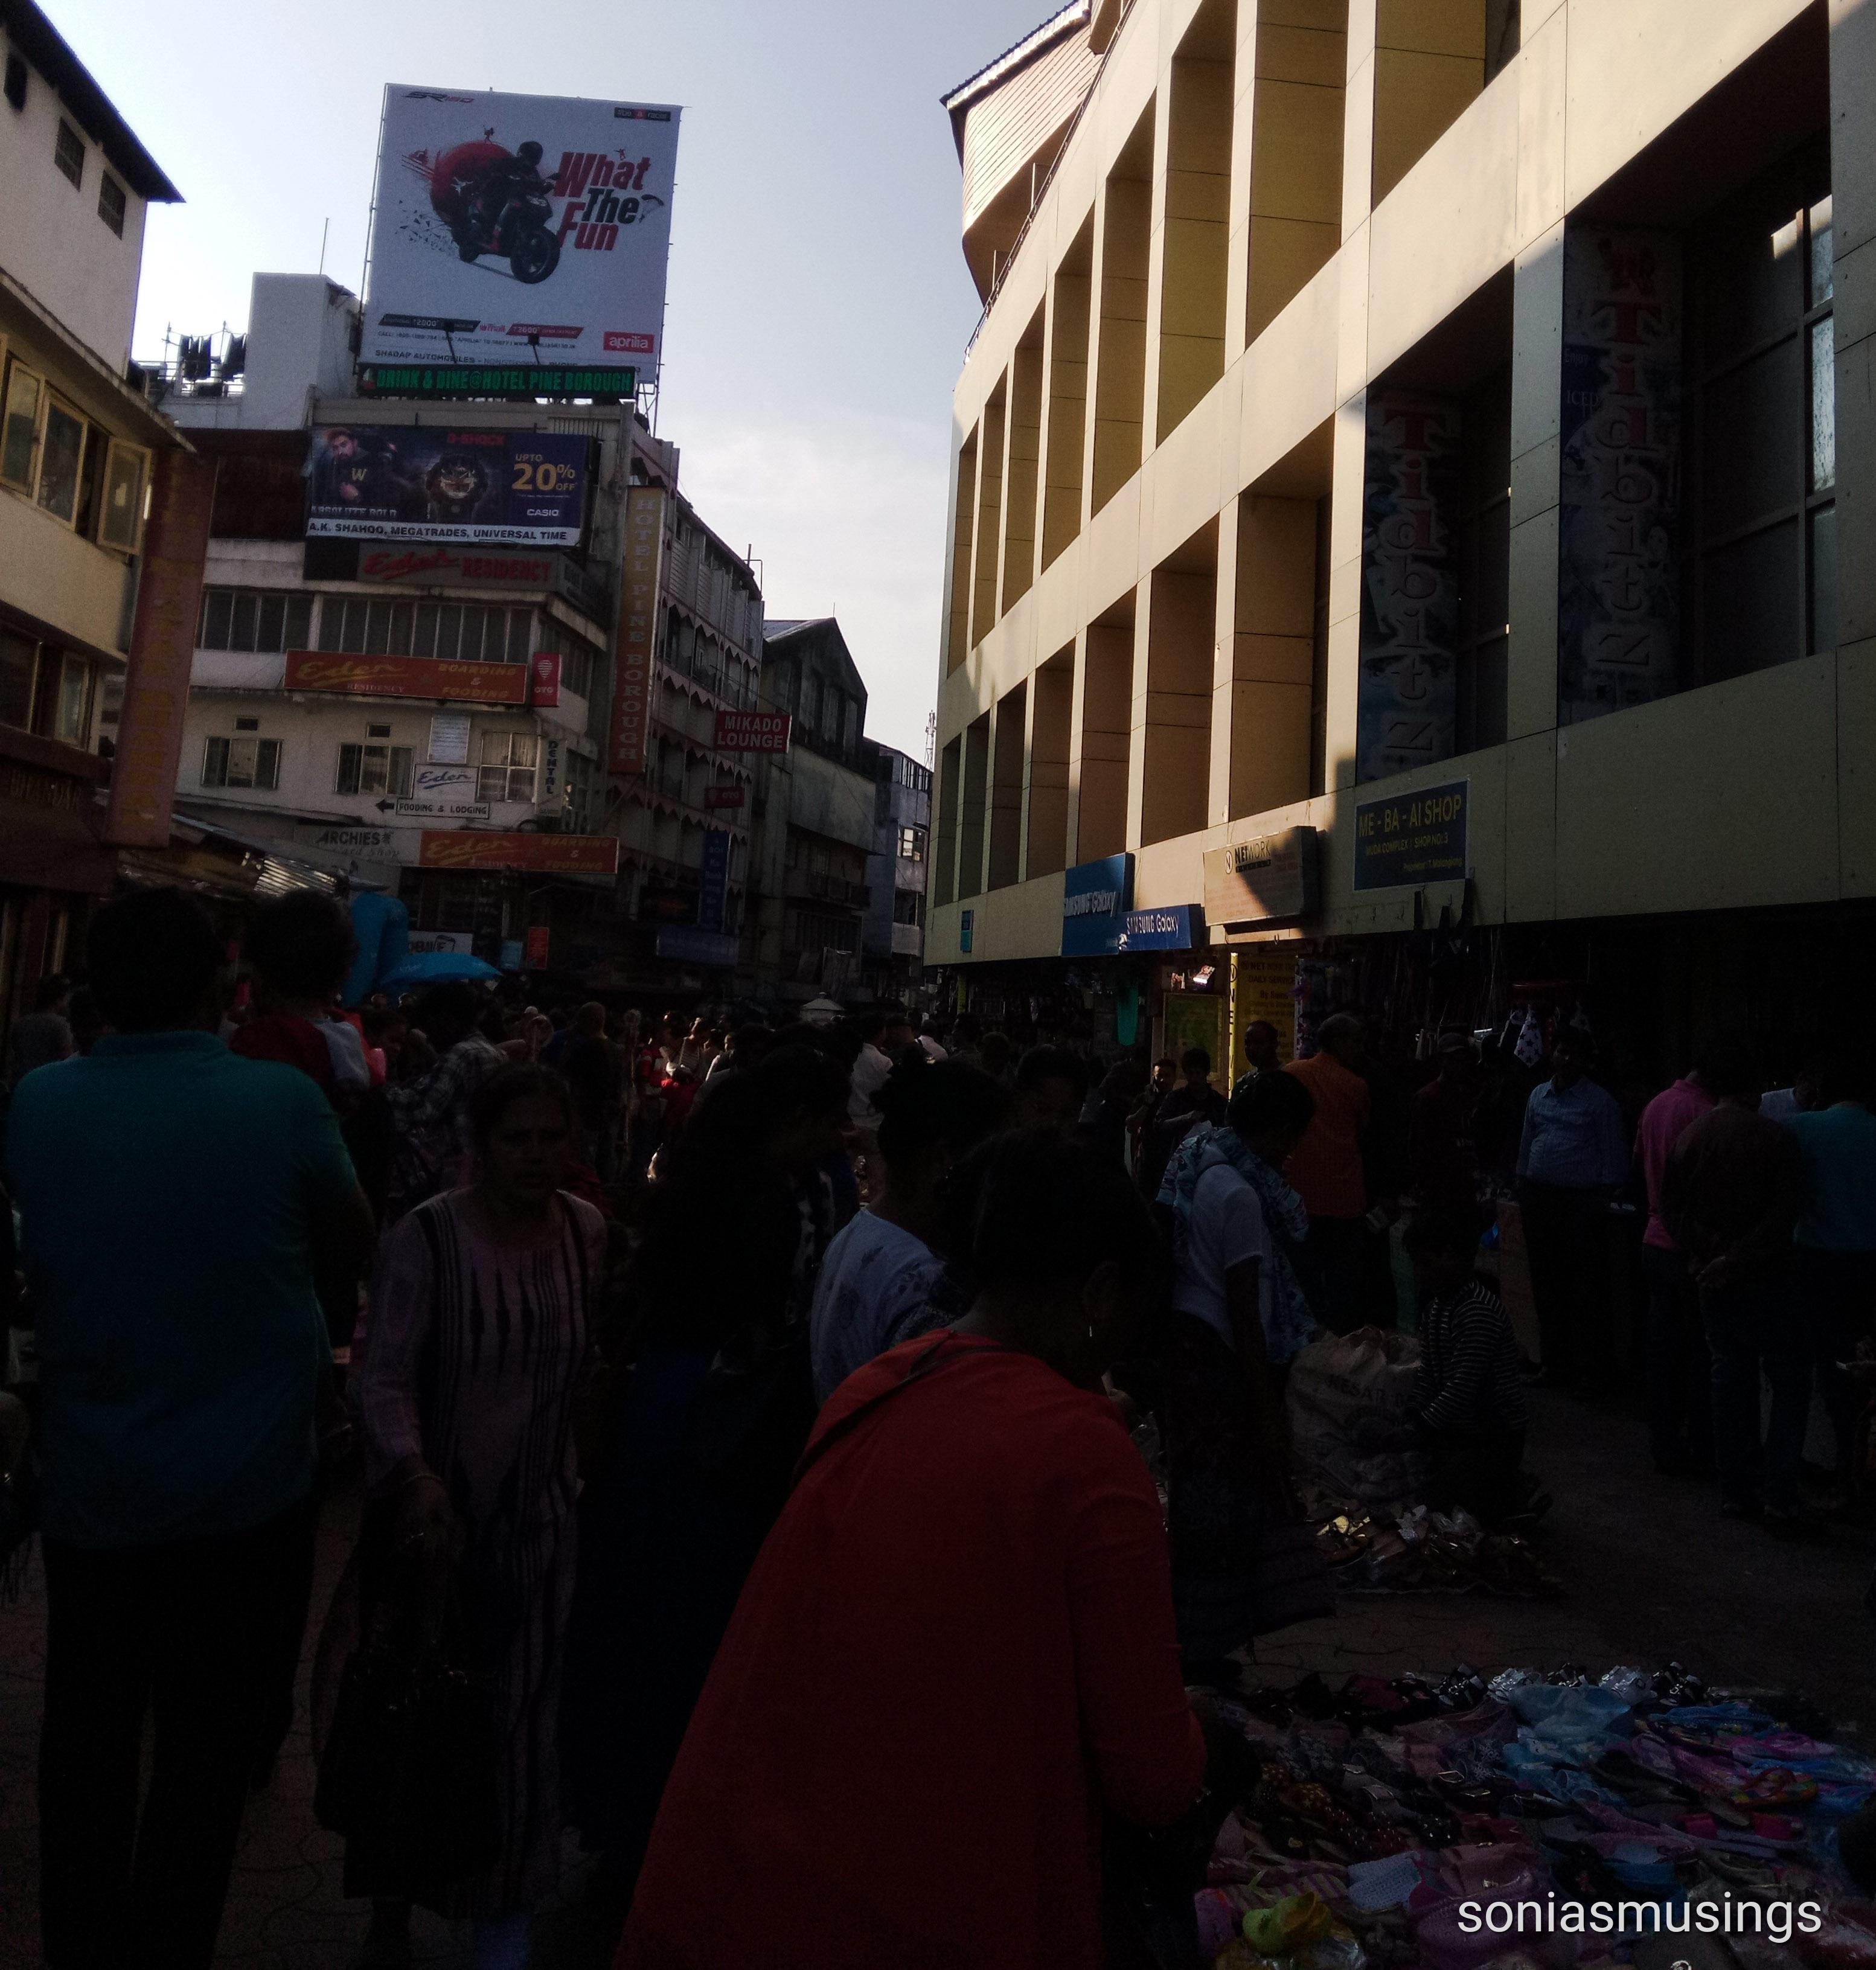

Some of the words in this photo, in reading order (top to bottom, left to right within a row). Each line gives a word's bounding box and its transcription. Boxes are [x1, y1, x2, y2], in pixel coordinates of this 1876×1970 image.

[554, 152, 651, 197] What
[581, 188, 639, 224] The
[557, 202, 619, 251] Fun
[376, 350, 411, 358] SHADAP
[609, 336, 648, 350] aprilia
[377, 369, 420, 389] DRINK
[528, 371, 562, 391] PINE
[565, 371, 632, 392] BOROUGH
[526, 508, 559, 517] CASIO
[473, 528, 537, 540] UNIVERSAL
[540, 531, 567, 540] TIME
[633, 499, 656, 572] HOTEL
[462, 557, 552, 582] RESIDENCY
[627, 584, 648, 642] PINE
[295, 660, 406, 686] Eden
[470, 677, 482, 686] &
[347, 683, 405, 694] RESIDENCY
[441, 686, 508, 699] FOODING
[617, 654, 644, 761] BOROUGH
[725, 715, 783, 732] MIKADO
[717, 731, 784, 749] LOUNGE
[417, 771, 475, 788] Eden
[399, 802, 432, 813] FOODING
[450, 806, 487, 815] LODGING
[1359, 812, 1375, 837] ME
[1384, 807, 1400, 833] BA
[1424, 793, 1462, 826] SHOP
[315, 831, 380, 845] ARCHIES
[426, 837, 516, 865] Eden
[1235, 840, 1272, 864] NETWORK
[1125, 913, 1155, 935] SAMSUNG
[1156, 912, 1179, 938] Galaxy
